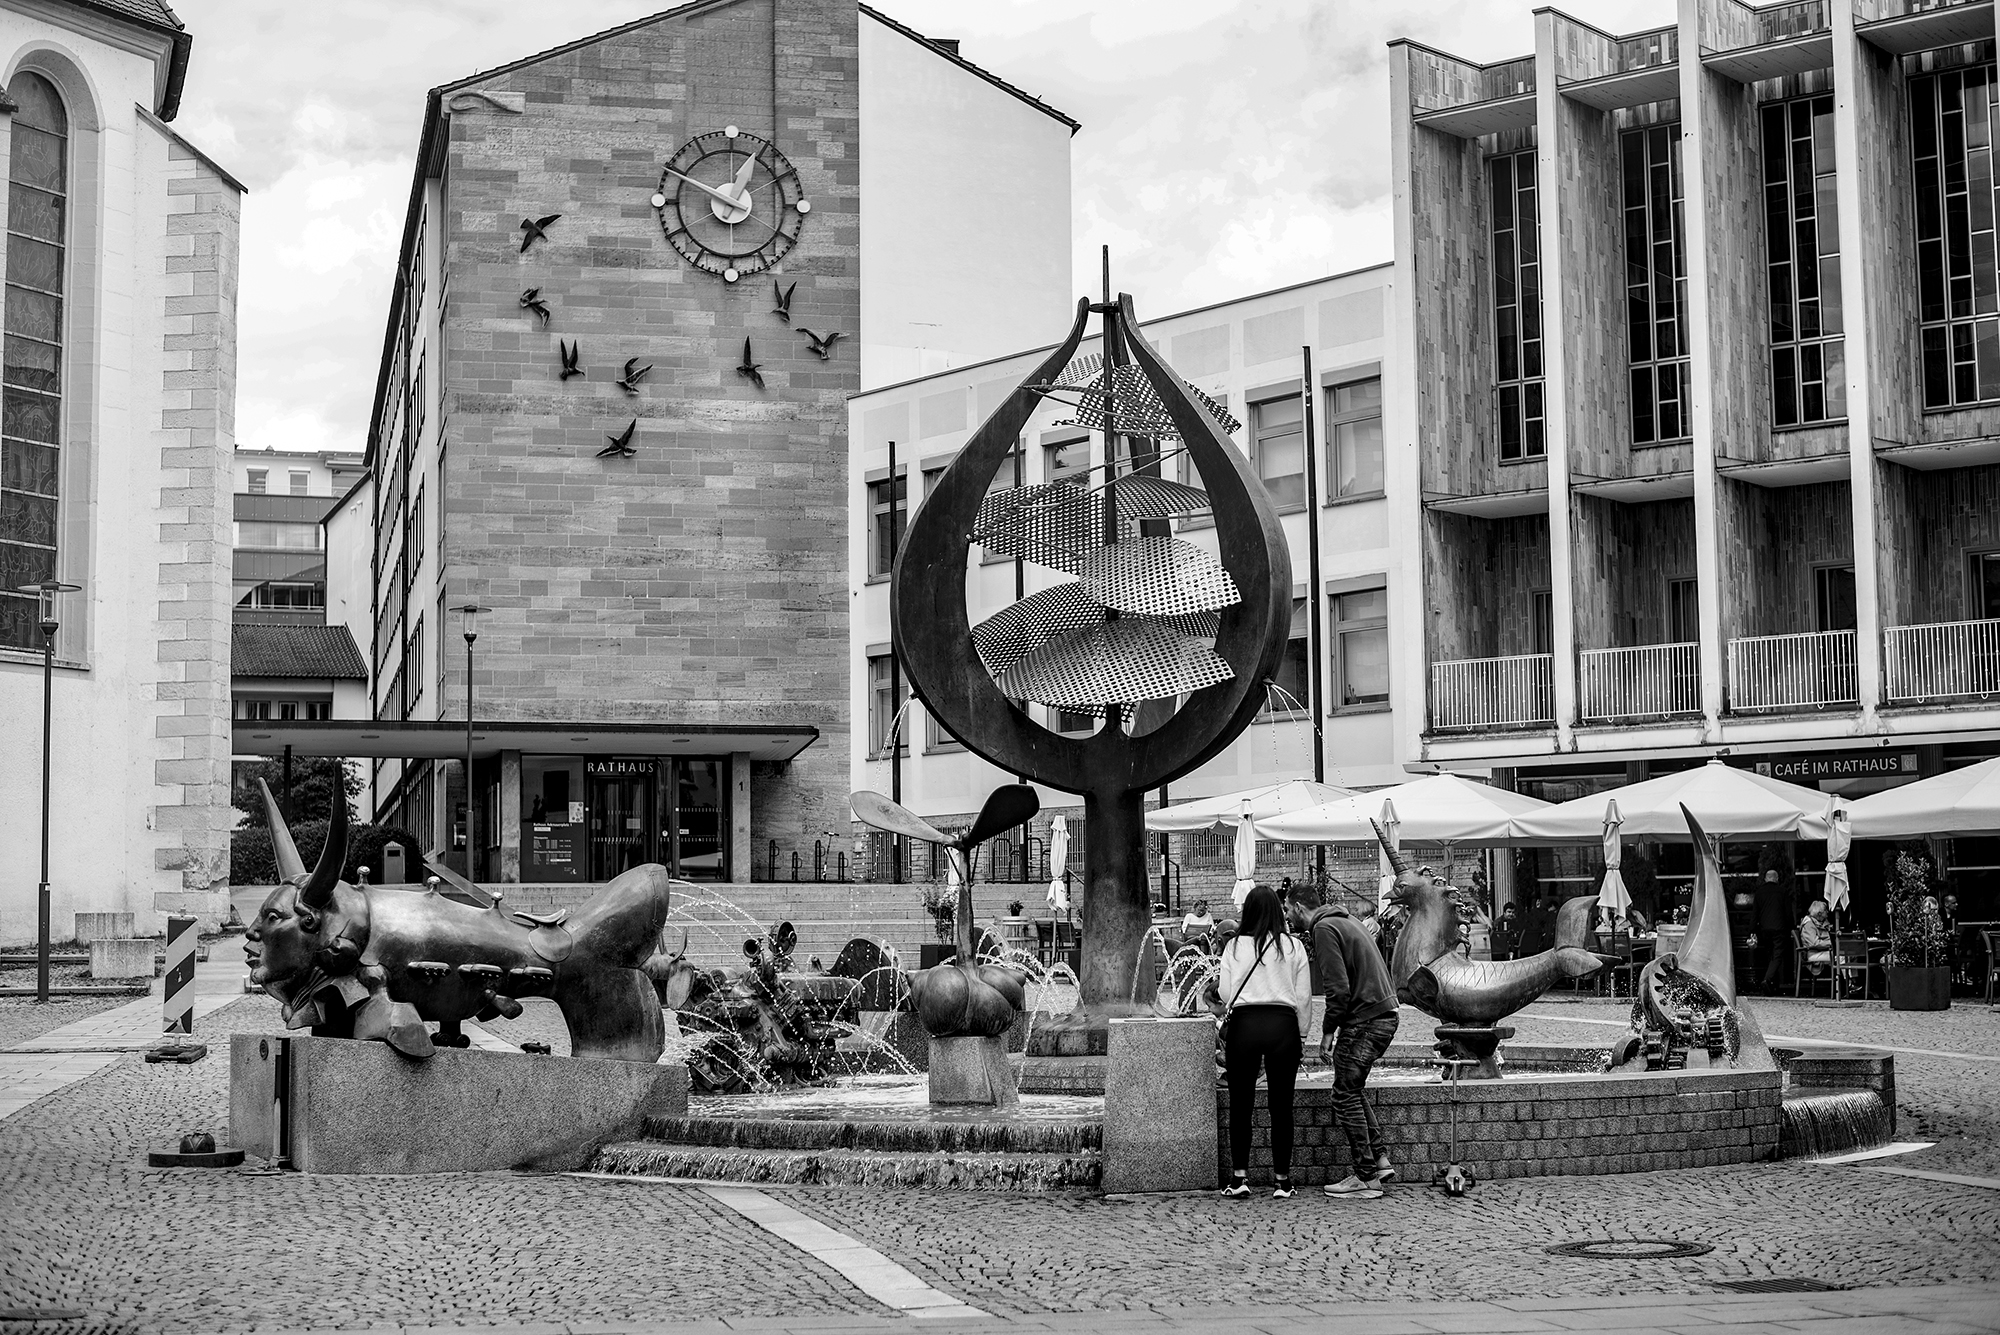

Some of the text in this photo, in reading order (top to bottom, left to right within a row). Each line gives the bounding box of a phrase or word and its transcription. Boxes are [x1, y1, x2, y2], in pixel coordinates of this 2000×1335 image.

[587, 761, 654, 772] RATHAUS
[1774, 758, 1810, 776] CAFÉ
[1813, 761, 1829, 774] IM
[1833, 757, 1898, 773] RATHAUS
[738, 781, 744, 791] 1
